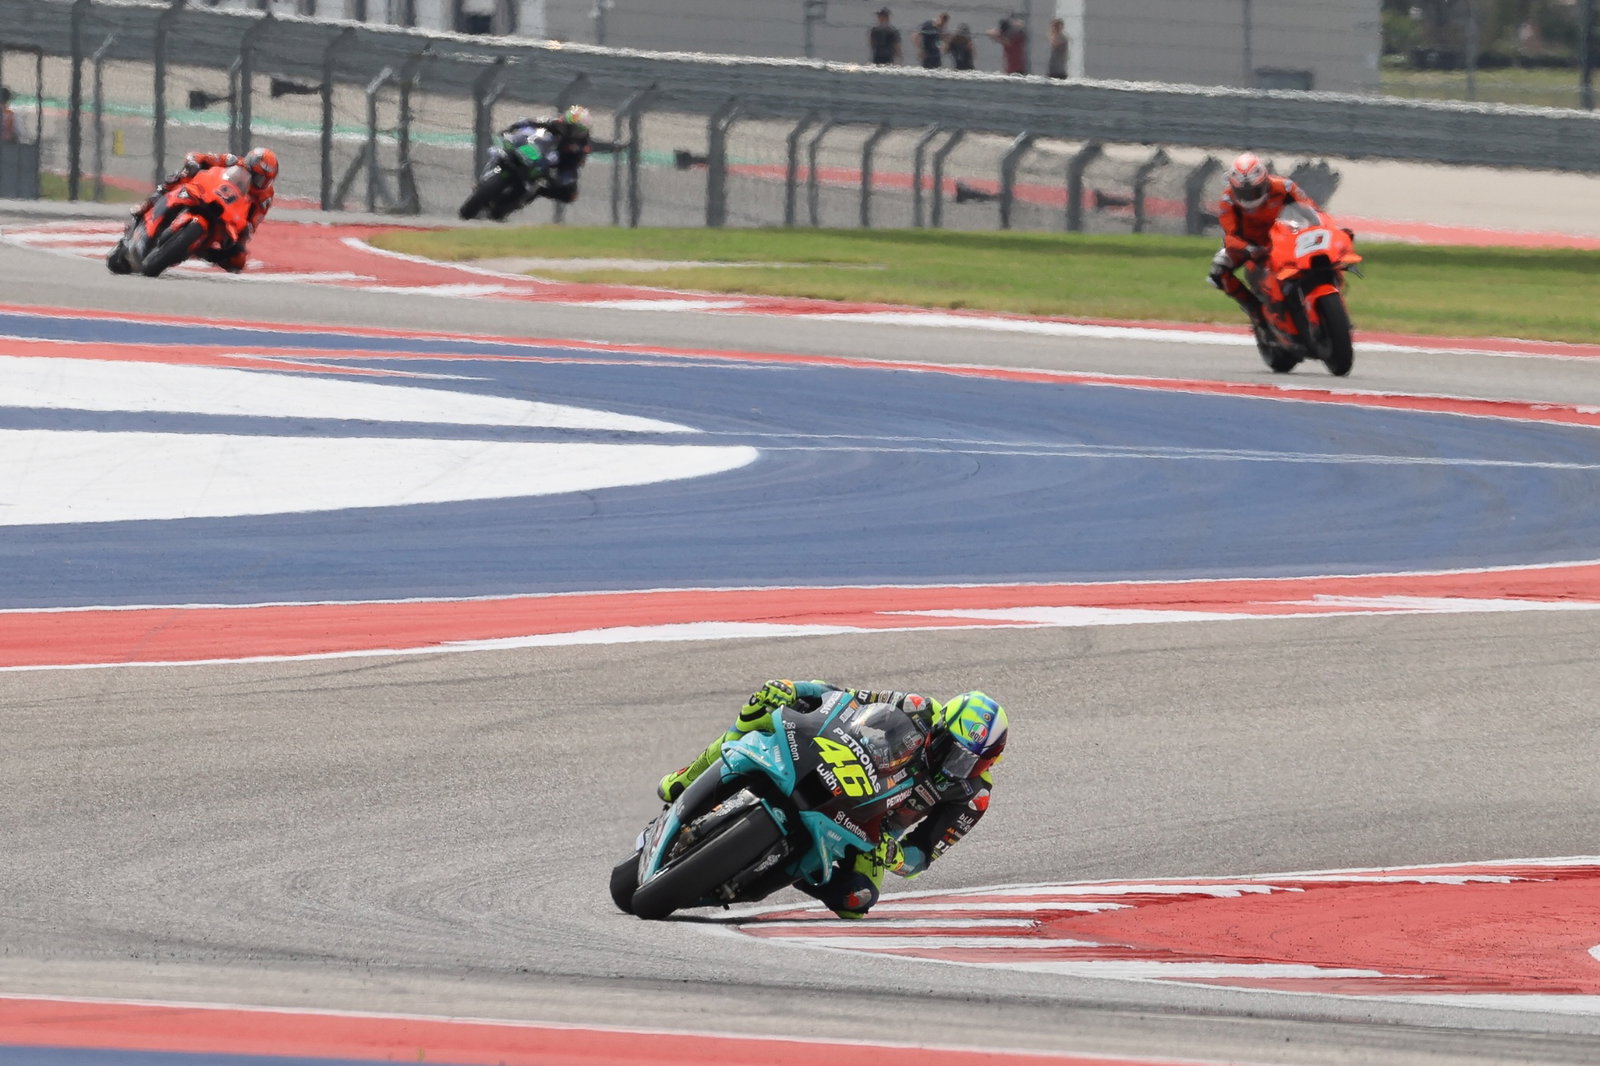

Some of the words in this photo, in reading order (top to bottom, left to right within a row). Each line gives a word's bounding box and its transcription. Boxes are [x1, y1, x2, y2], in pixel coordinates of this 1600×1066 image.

[786, 730, 800, 761] fantom
[813, 736, 874, 797] 46
[833, 727, 881, 793] PETRONAS
[843, 817, 868, 839] fantom
